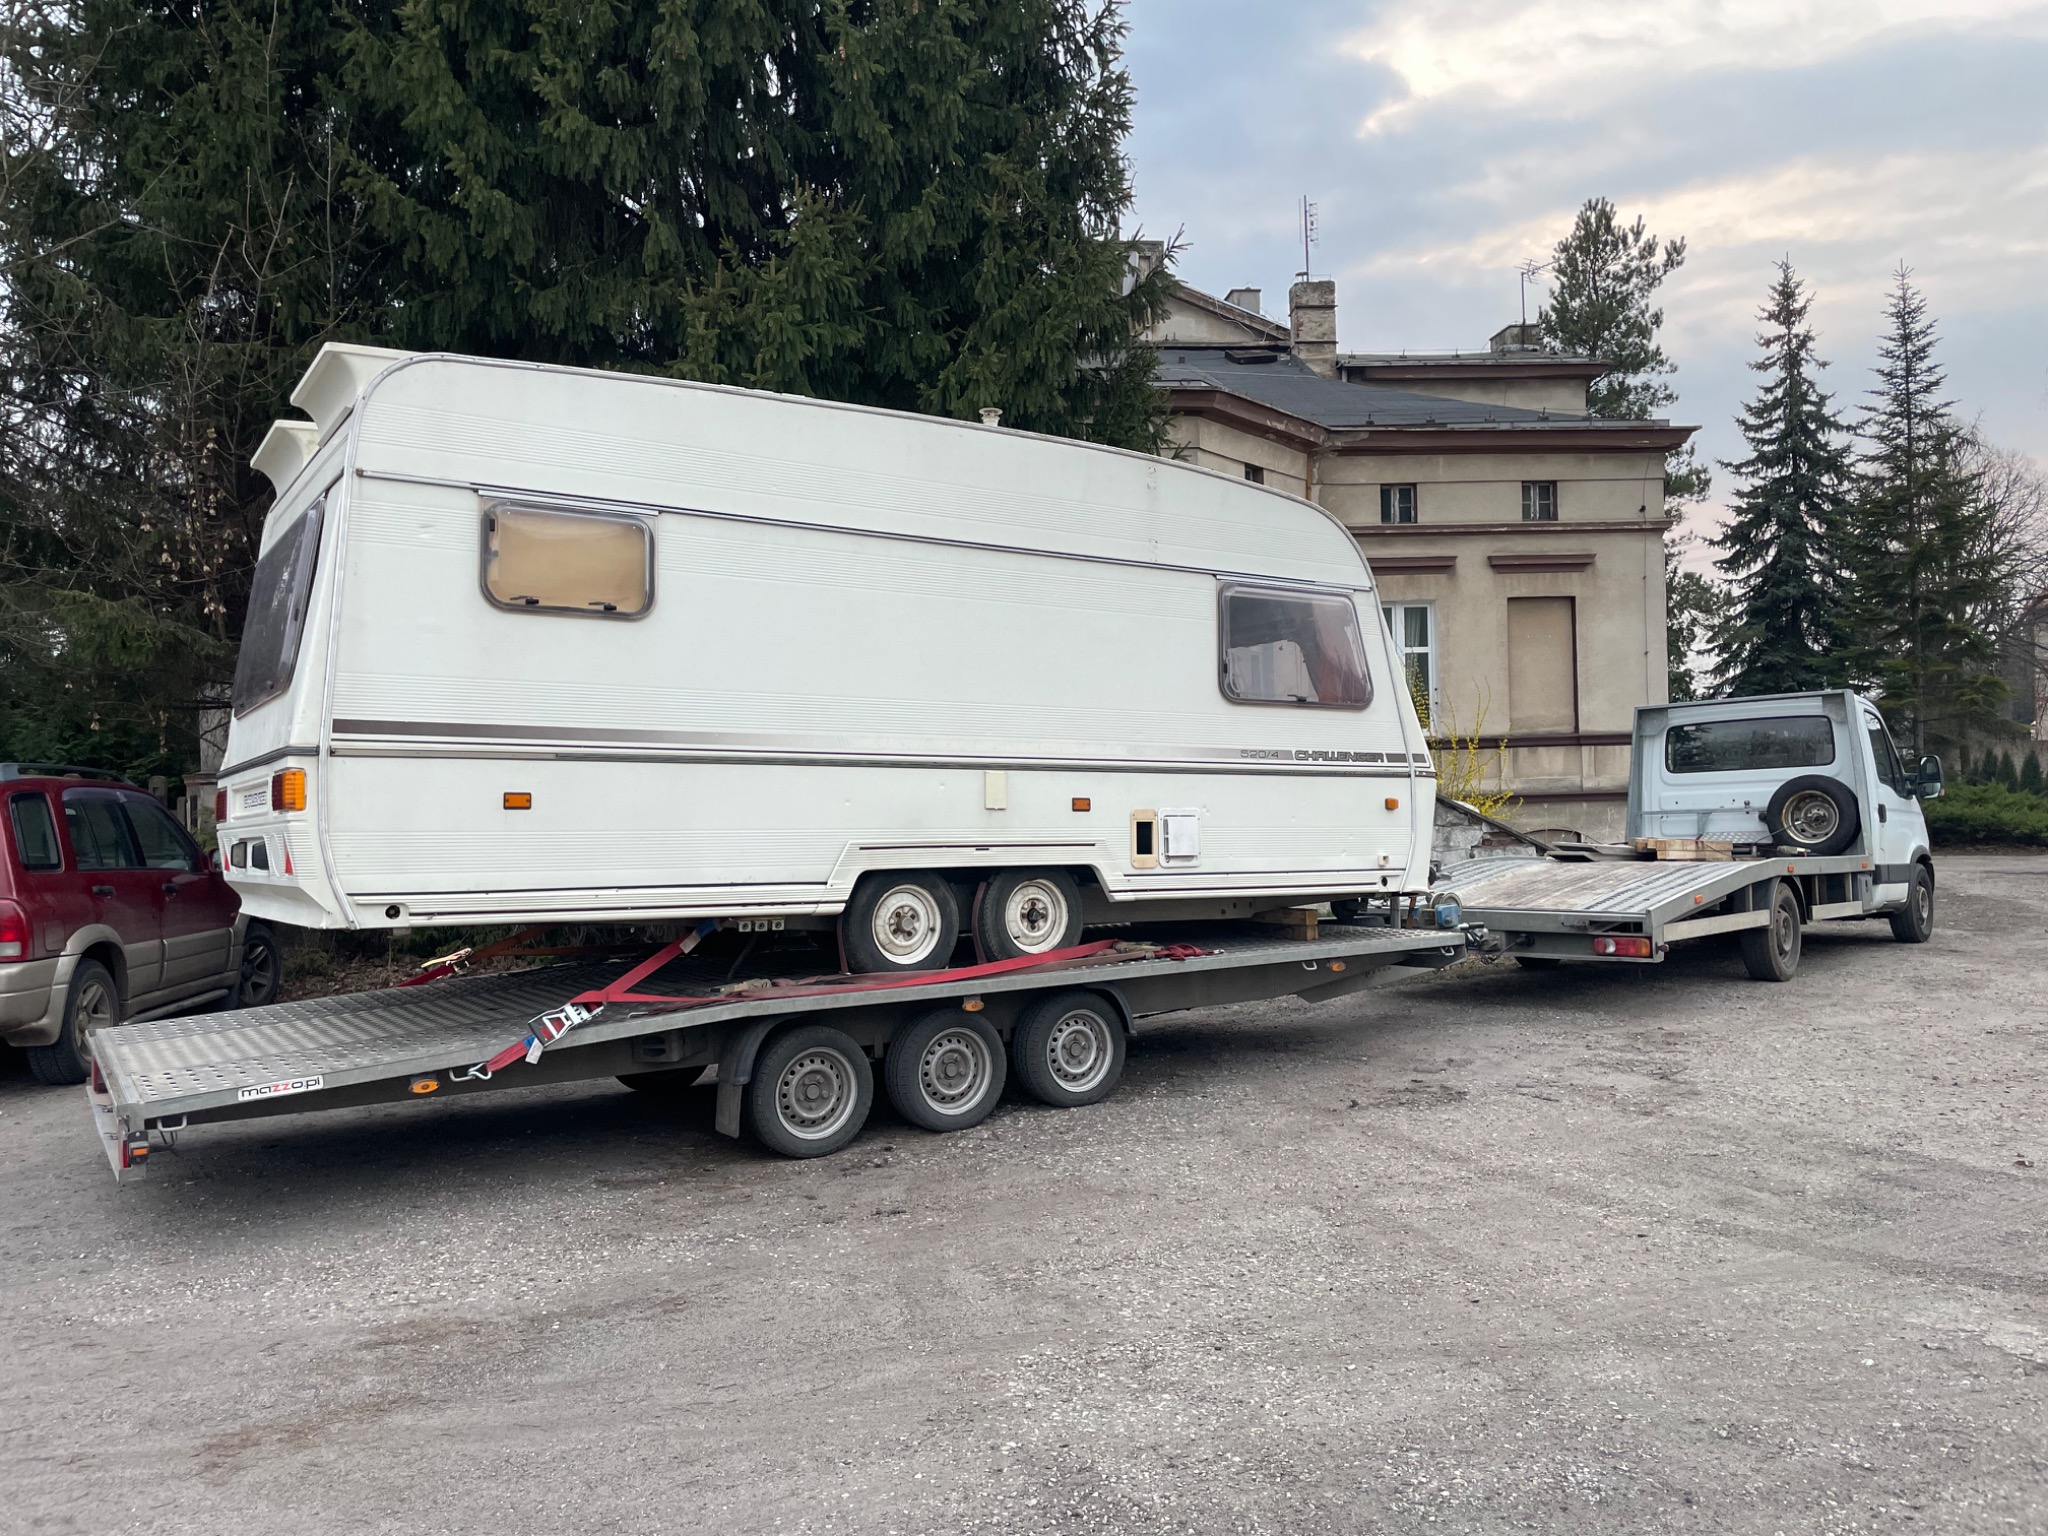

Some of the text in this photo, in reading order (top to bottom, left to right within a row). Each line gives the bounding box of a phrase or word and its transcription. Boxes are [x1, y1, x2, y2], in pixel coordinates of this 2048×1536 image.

[1240, 749, 1385, 763] 520/4 CHALLENGER
[241, 1077, 320, 1098] mazzo.pl
